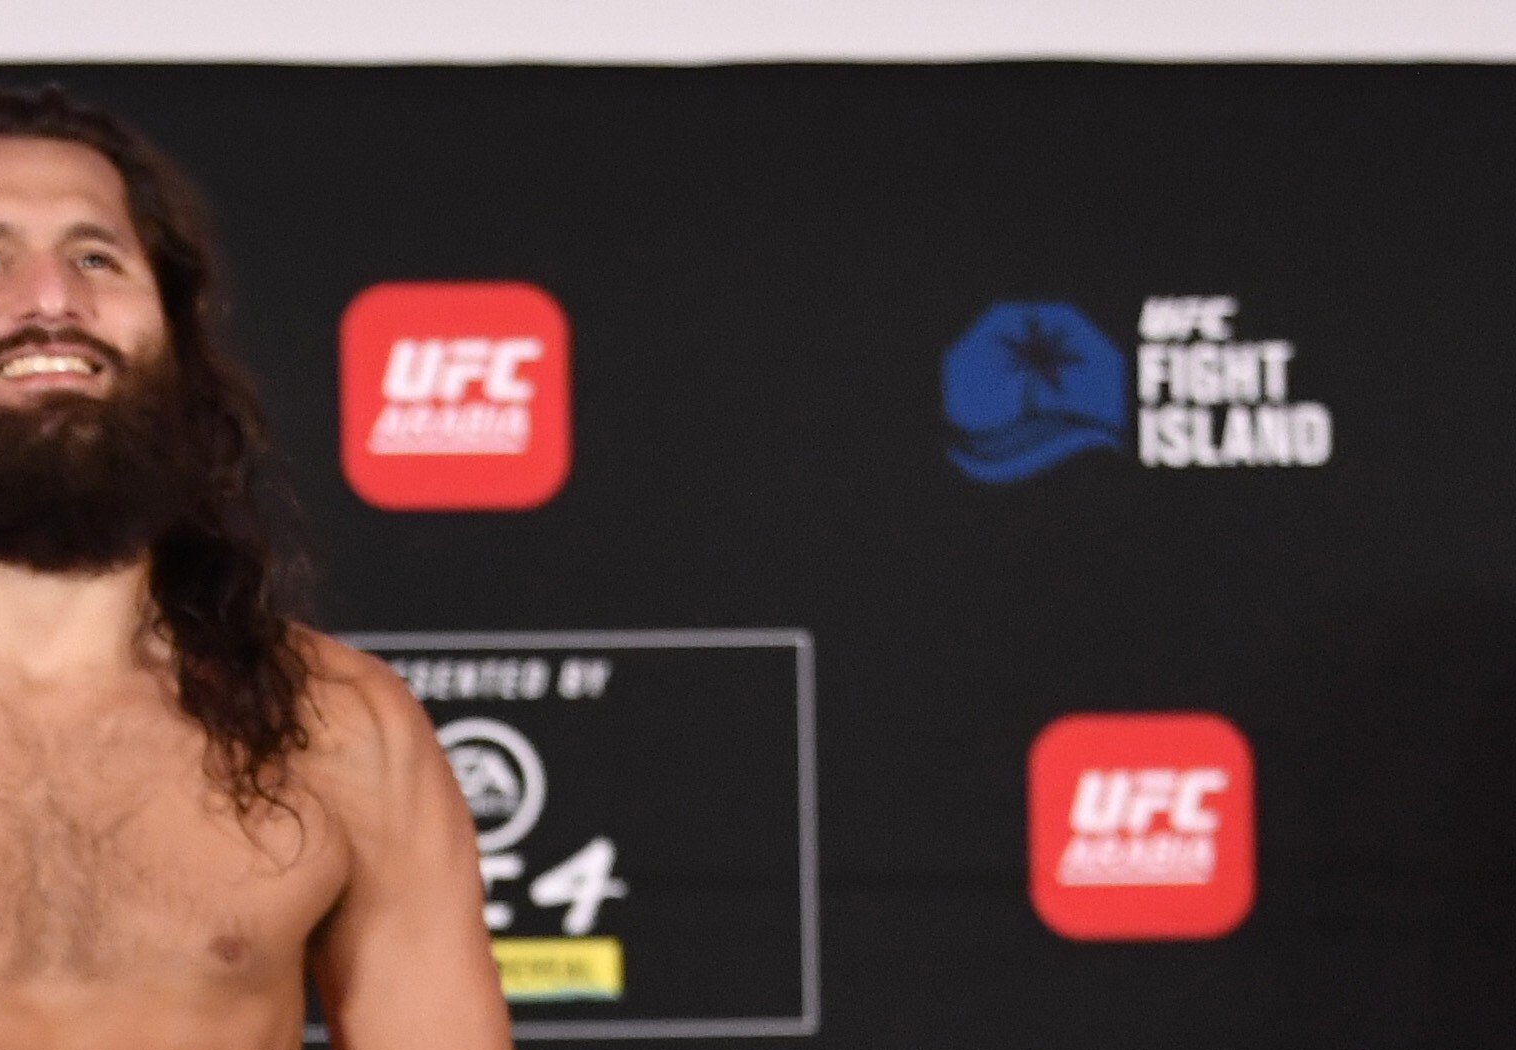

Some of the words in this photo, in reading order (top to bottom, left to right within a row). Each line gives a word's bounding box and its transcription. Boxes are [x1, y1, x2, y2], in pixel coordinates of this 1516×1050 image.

[1138, 296, 1236, 340] UFC
[382, 336, 544, 402] UFC
[1138, 340, 1293, 402] FIGHT
[1138, 403, 1333, 467] ISLAND
[1069, 767, 1229, 833] UFC
[530, 837, 629, 936] 4
